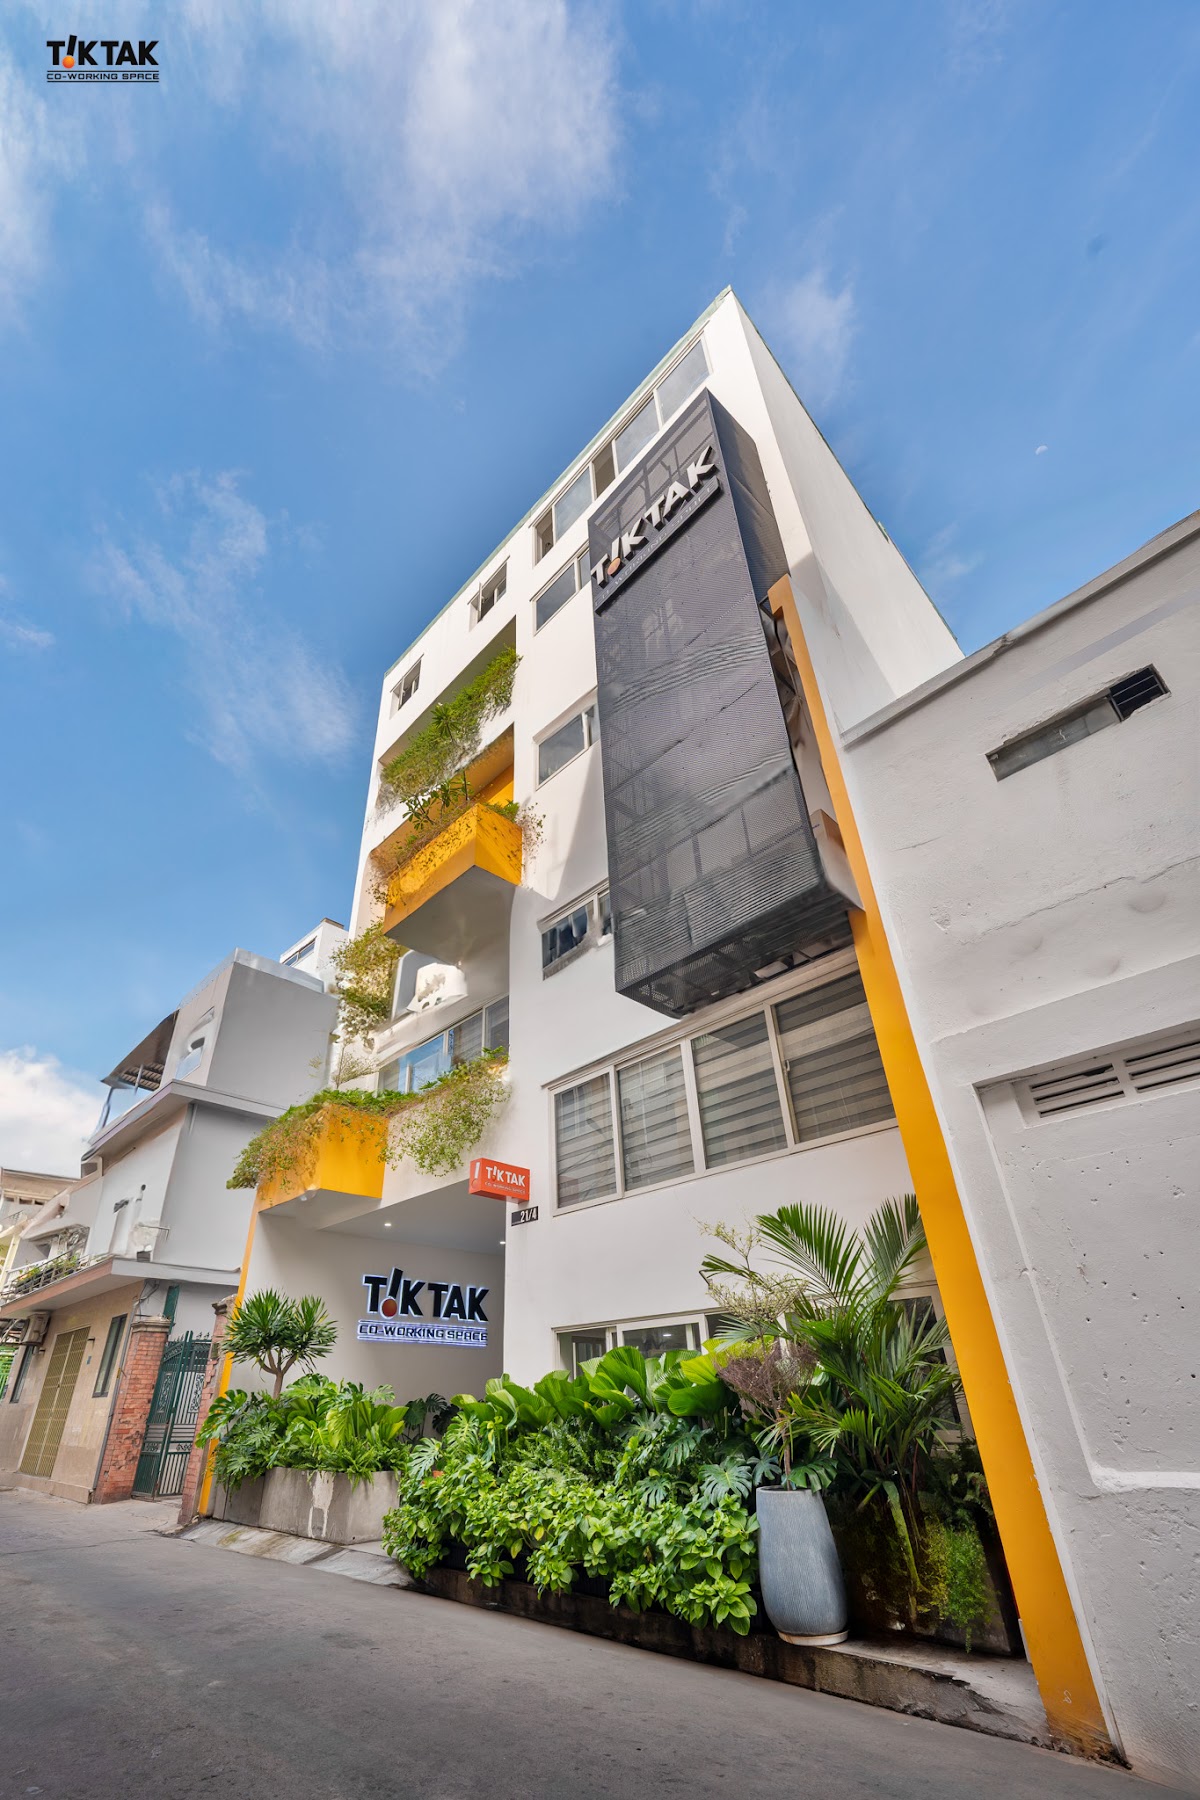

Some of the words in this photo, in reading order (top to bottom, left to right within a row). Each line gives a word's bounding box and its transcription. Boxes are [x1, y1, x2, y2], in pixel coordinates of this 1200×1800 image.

[520, 1207, 538, 1223] 21/4
[358, 1323, 444, 1338] CO-WORKING
[446, 1329, 488, 1342] SPACE
